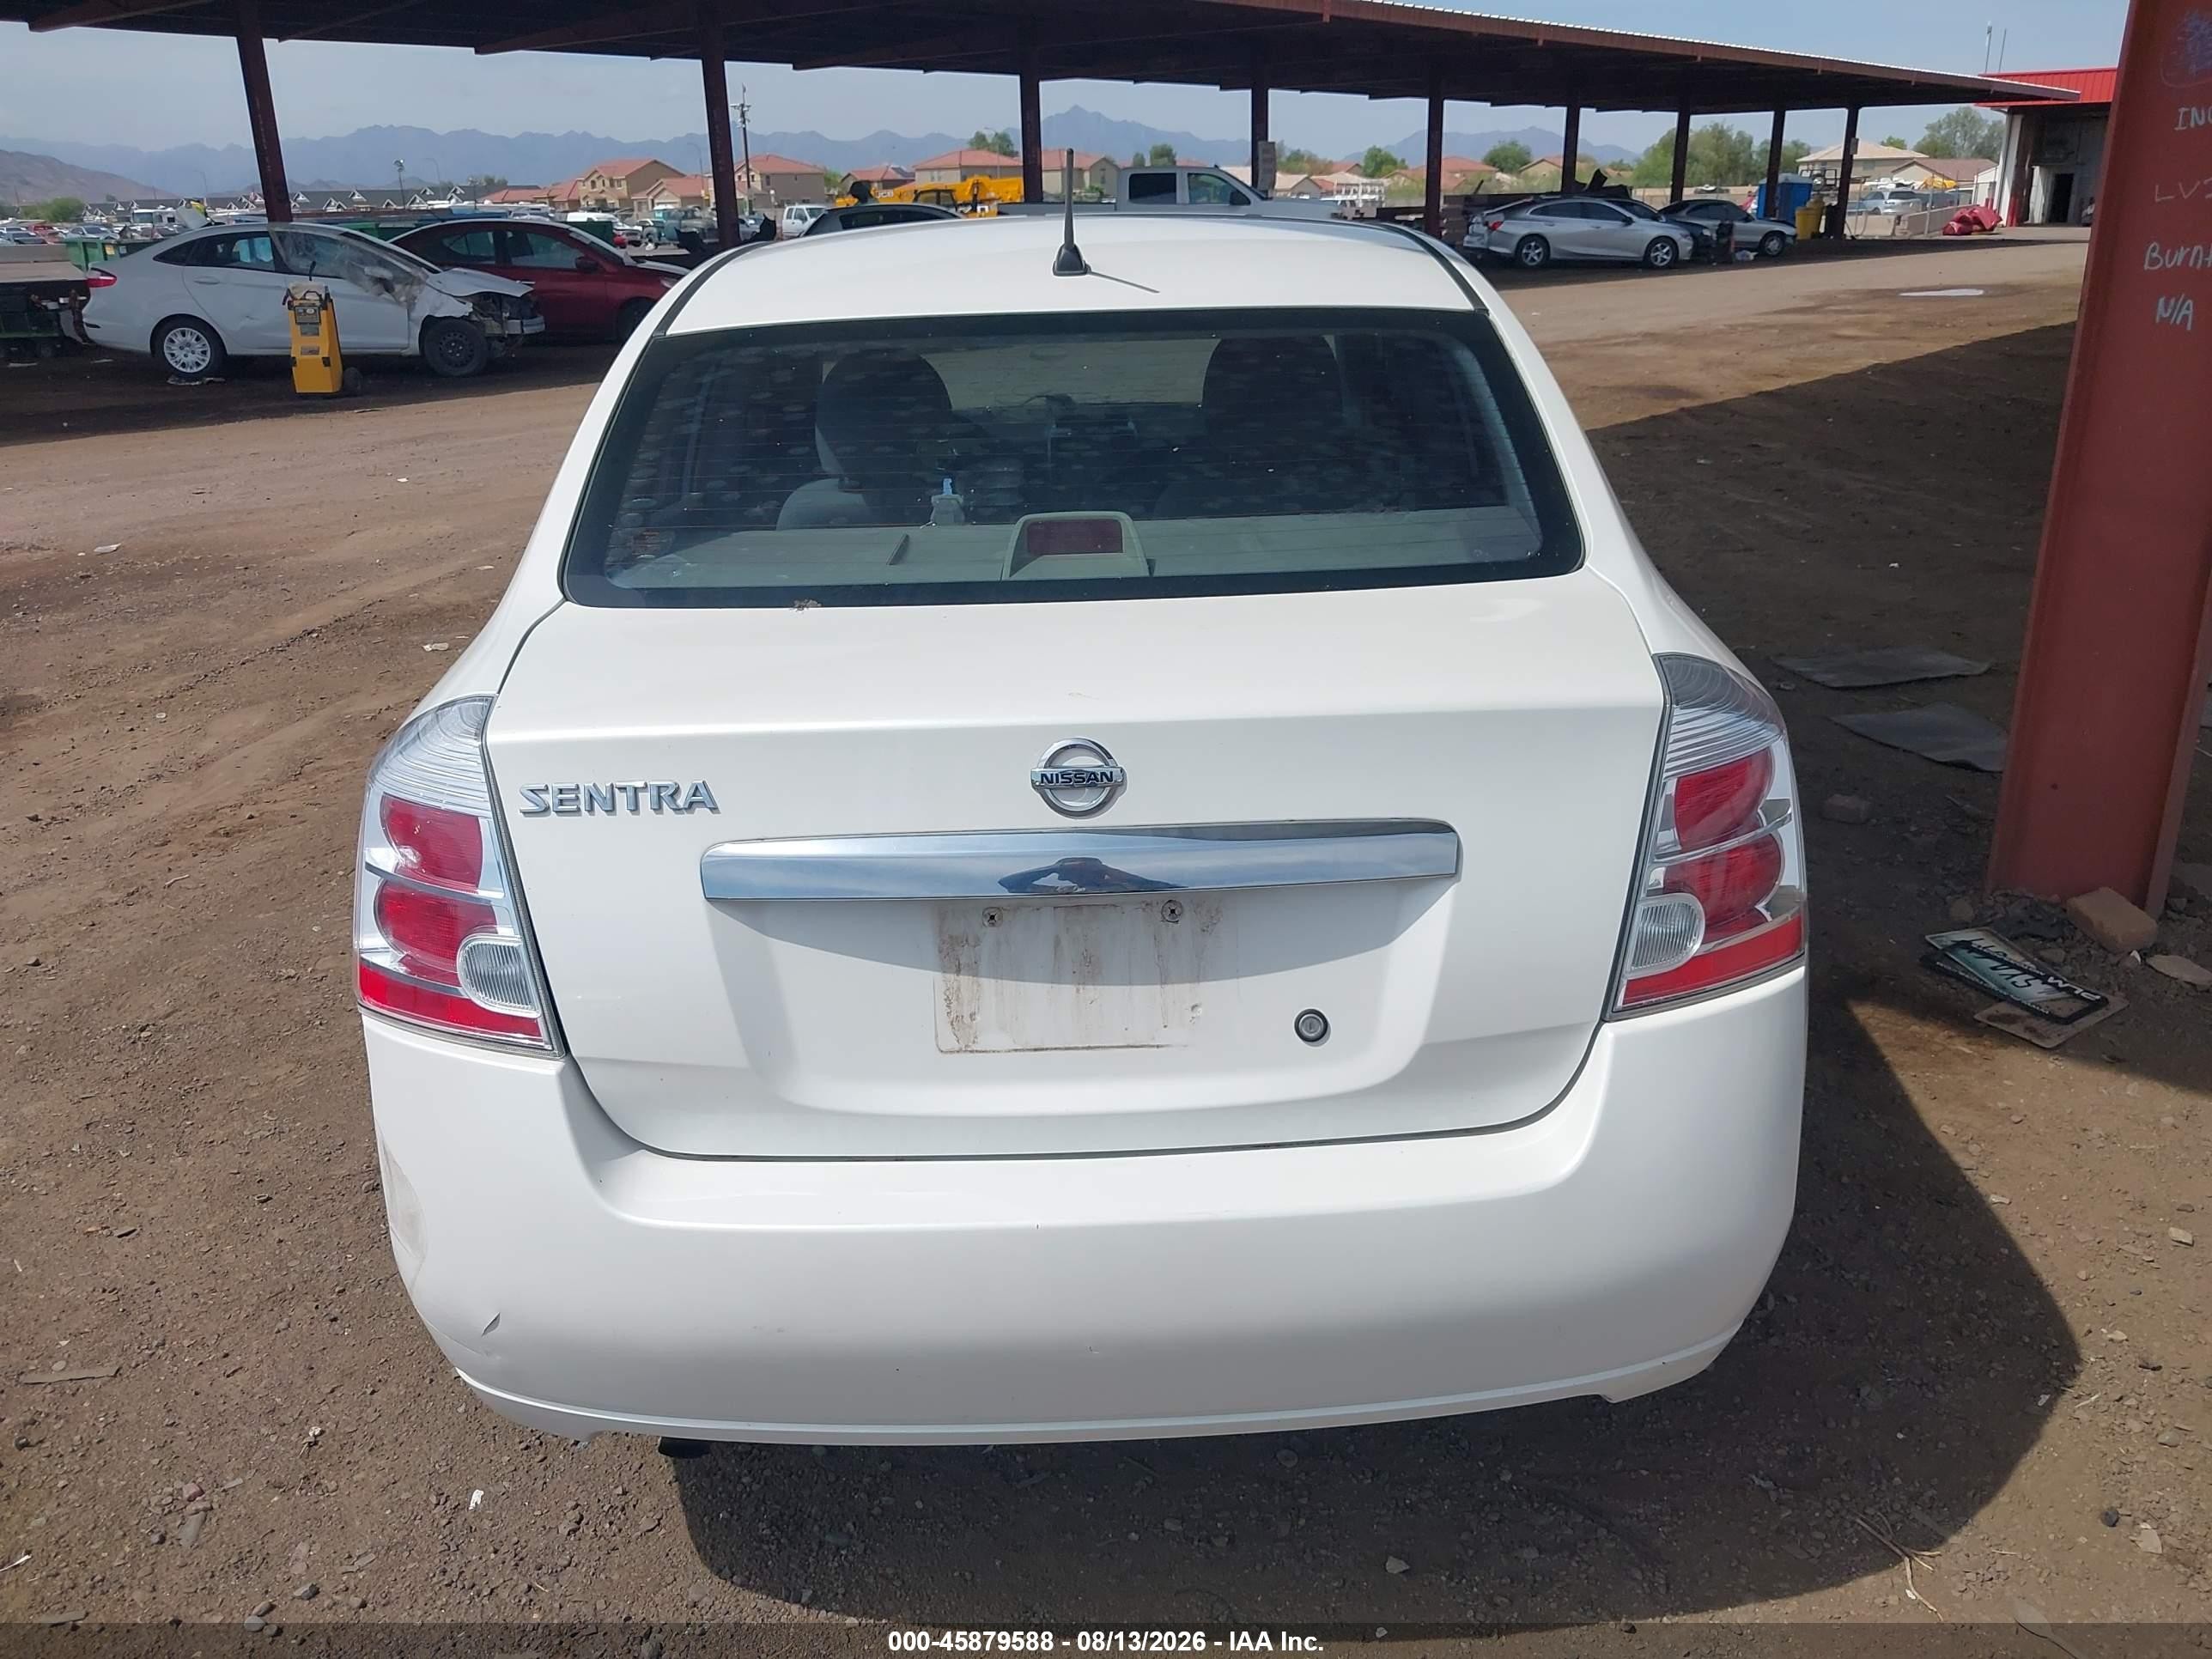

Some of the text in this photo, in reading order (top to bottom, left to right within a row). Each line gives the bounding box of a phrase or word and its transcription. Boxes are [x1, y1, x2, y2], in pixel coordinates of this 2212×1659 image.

[2155, 294, 2194, 331] N/A
[1039, 769, 1115, 785] NISSAN
[519, 780, 720, 817] SENTRA
